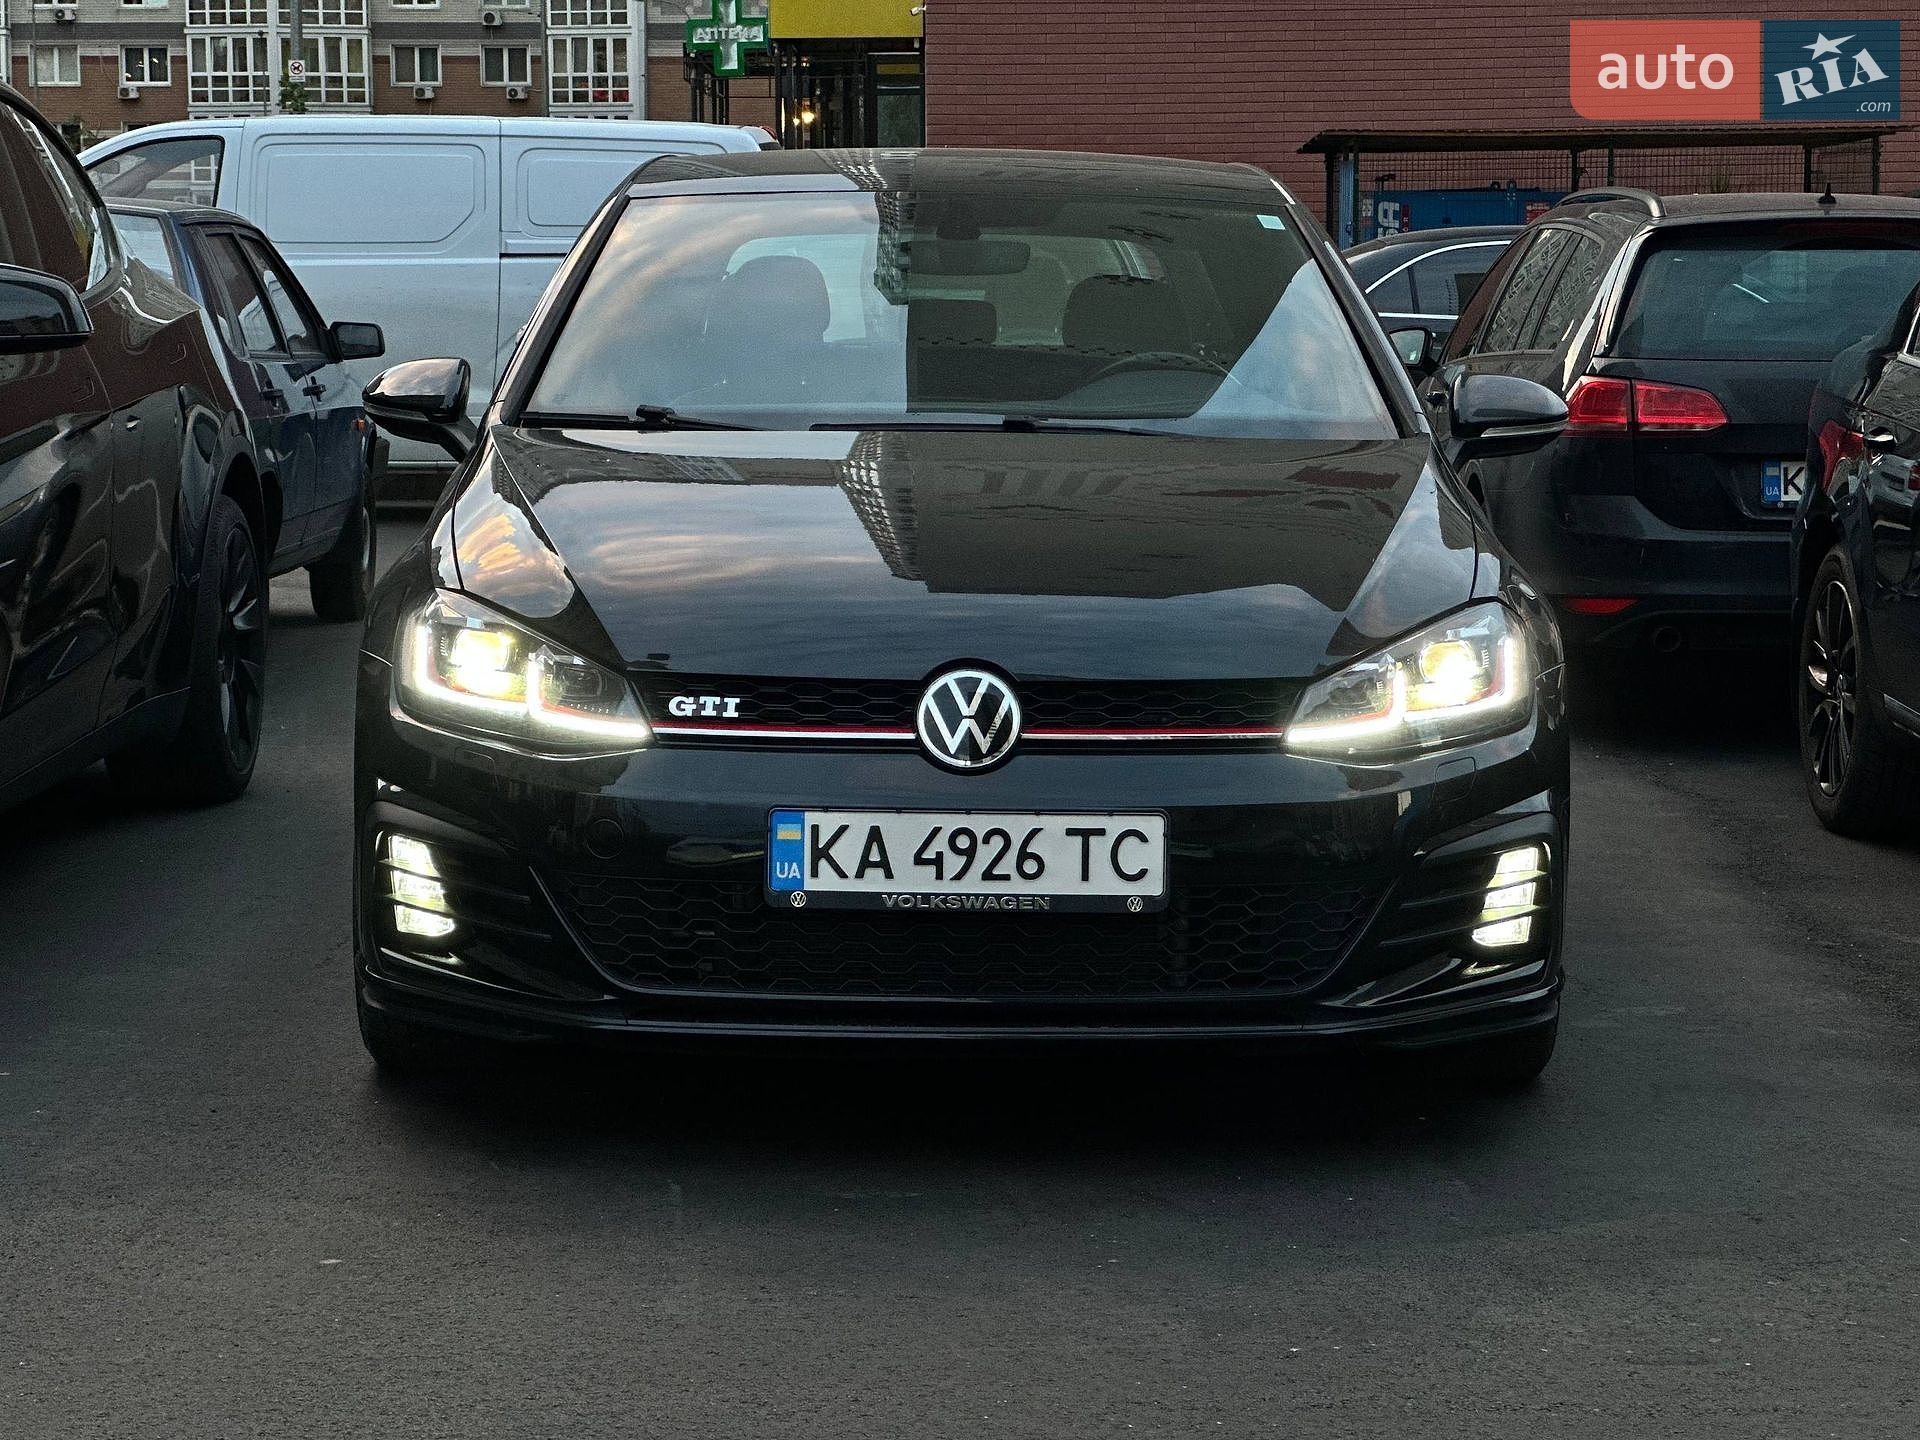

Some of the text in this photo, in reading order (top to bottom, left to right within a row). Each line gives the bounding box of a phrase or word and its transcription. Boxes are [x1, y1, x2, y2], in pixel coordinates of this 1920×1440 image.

[1765, 486, 1780, 496] UA
[668, 696, 740, 718] GTI
[809, 824, 1150, 882] KA 4926 TC
[776, 861, 801, 880] UA
[881, 894, 1051, 911] VOLKSWAGEN
